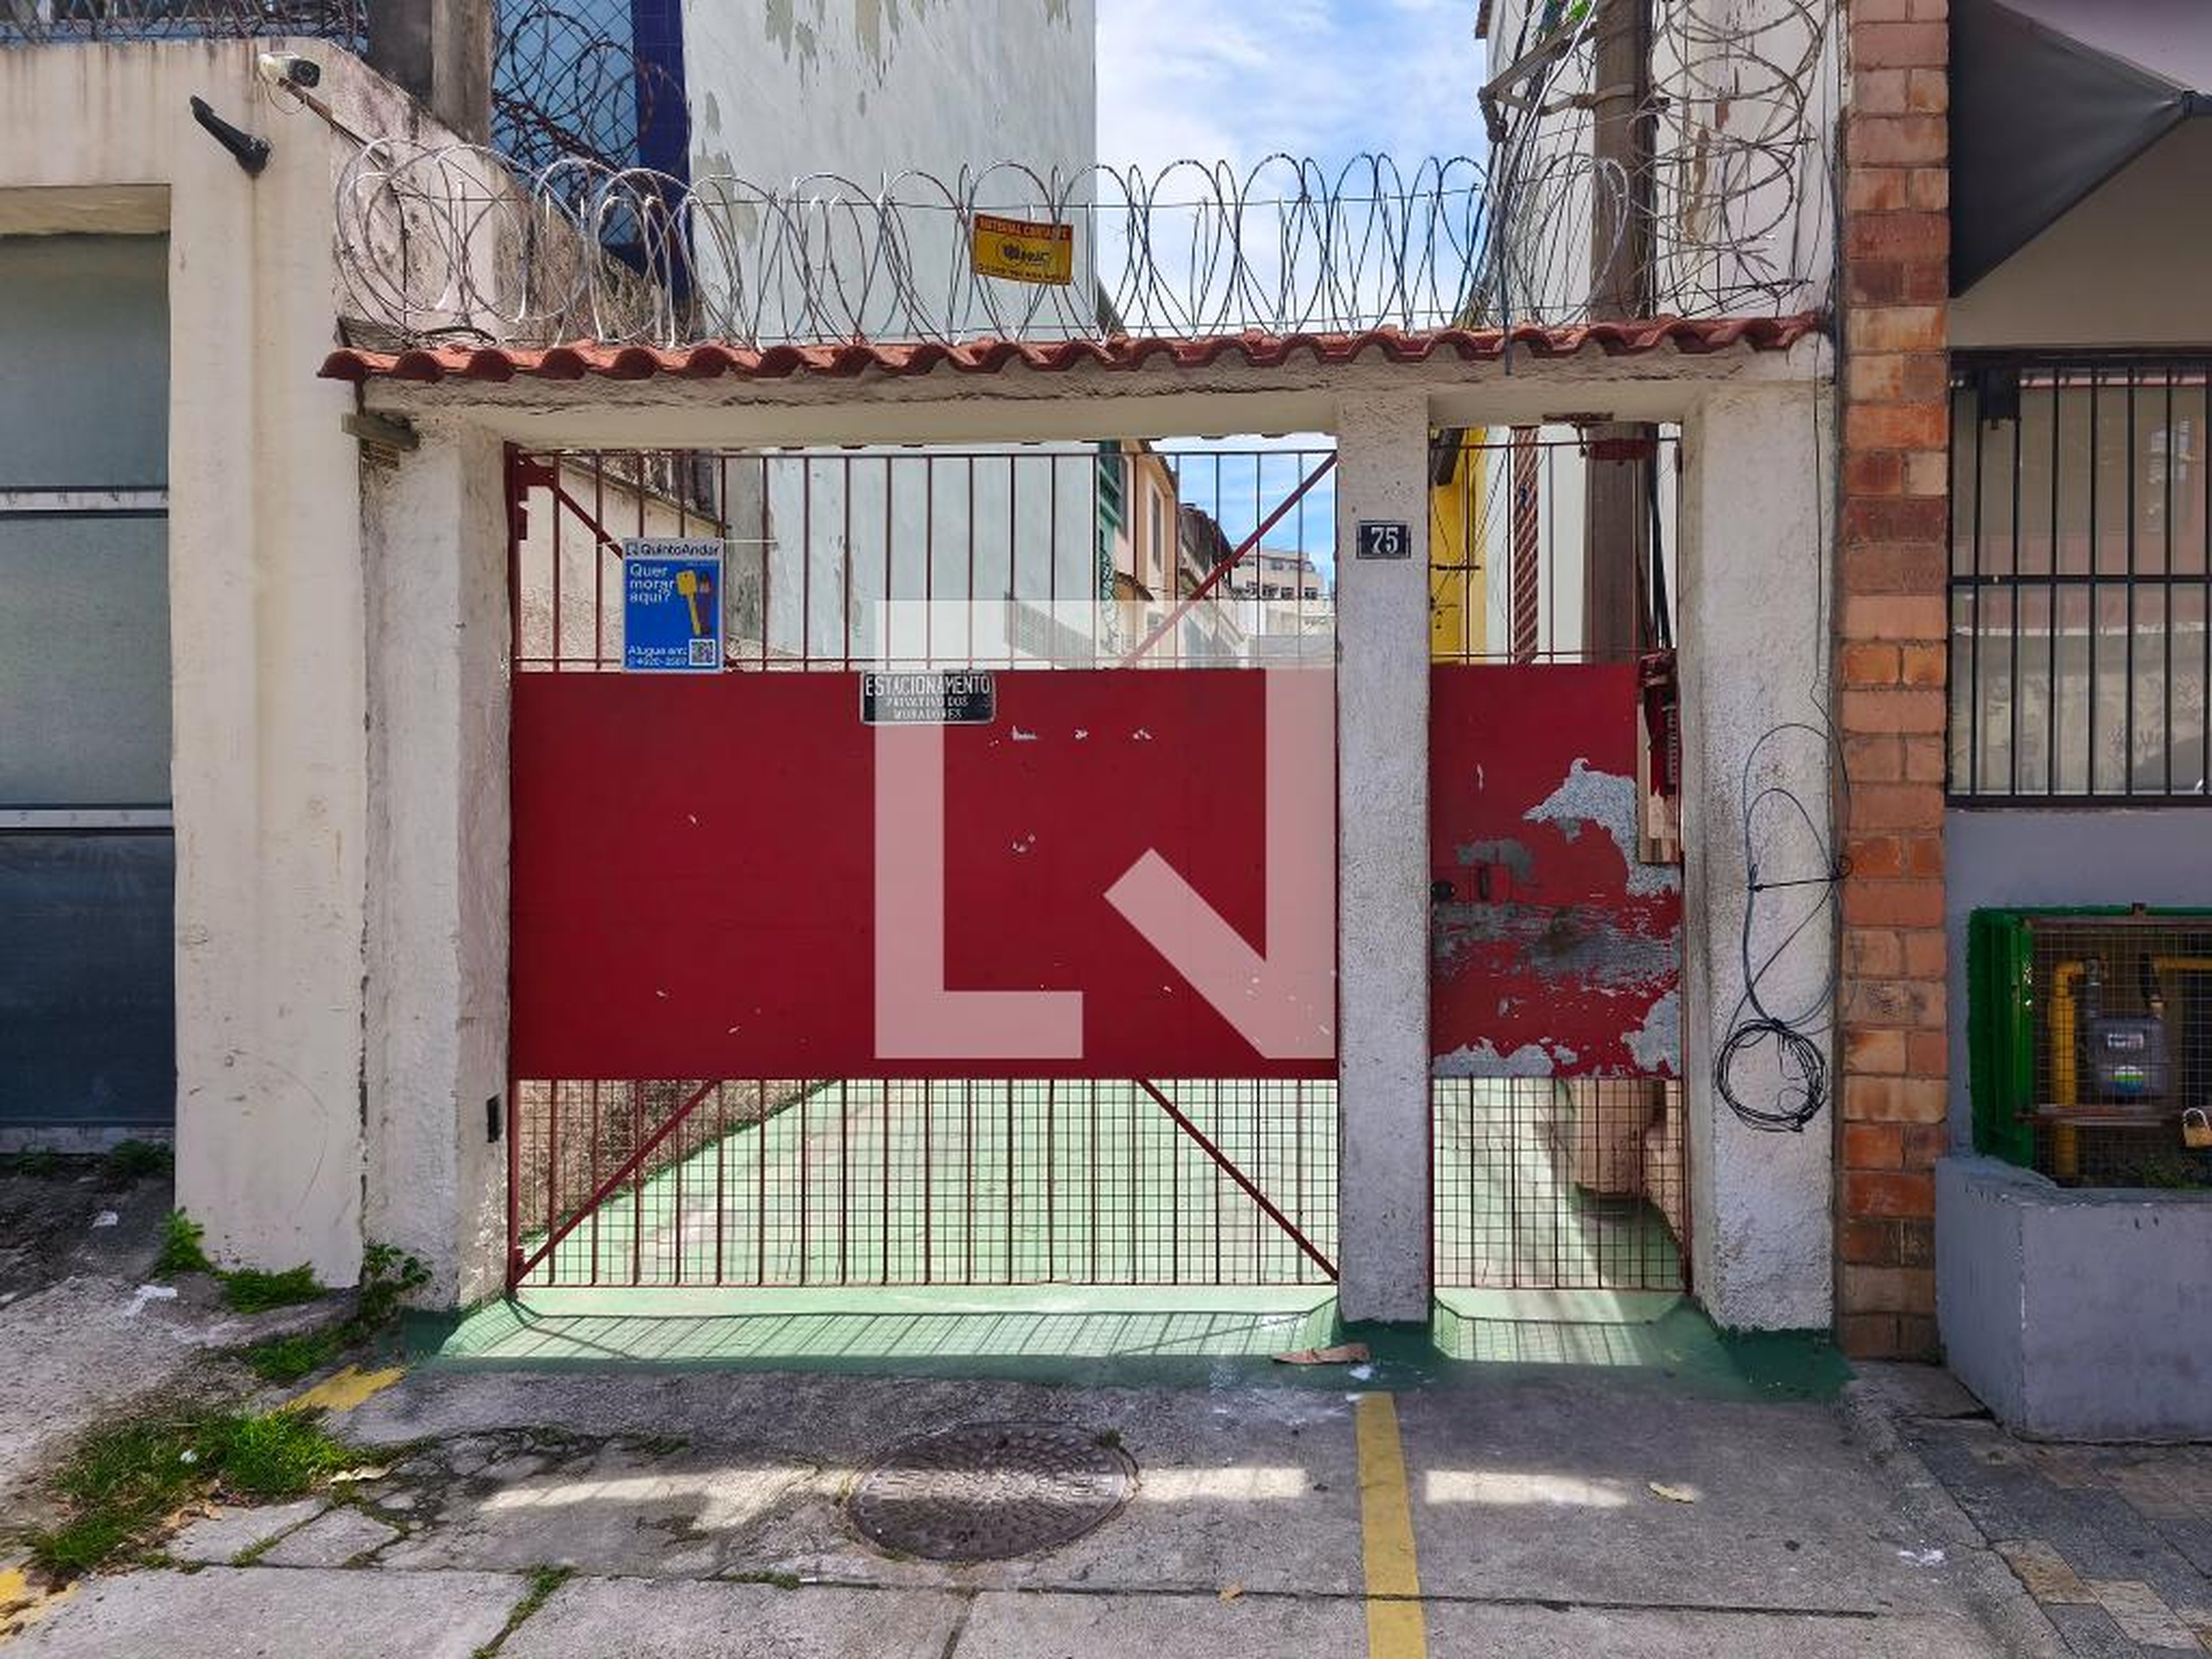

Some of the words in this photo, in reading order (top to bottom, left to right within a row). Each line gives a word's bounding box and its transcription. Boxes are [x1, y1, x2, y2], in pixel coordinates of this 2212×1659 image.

[1371, 527, 1399, 554] 75
[641, 543, 719, 556] QuintoAndar
[630, 563, 668, 578] Quer
[630, 579, 675, 590] morar
[630, 589, 671, 605] aqui?
[865, 675, 990, 696] ESTACIONAMENTO
[948, 695, 969, 707] DOS
